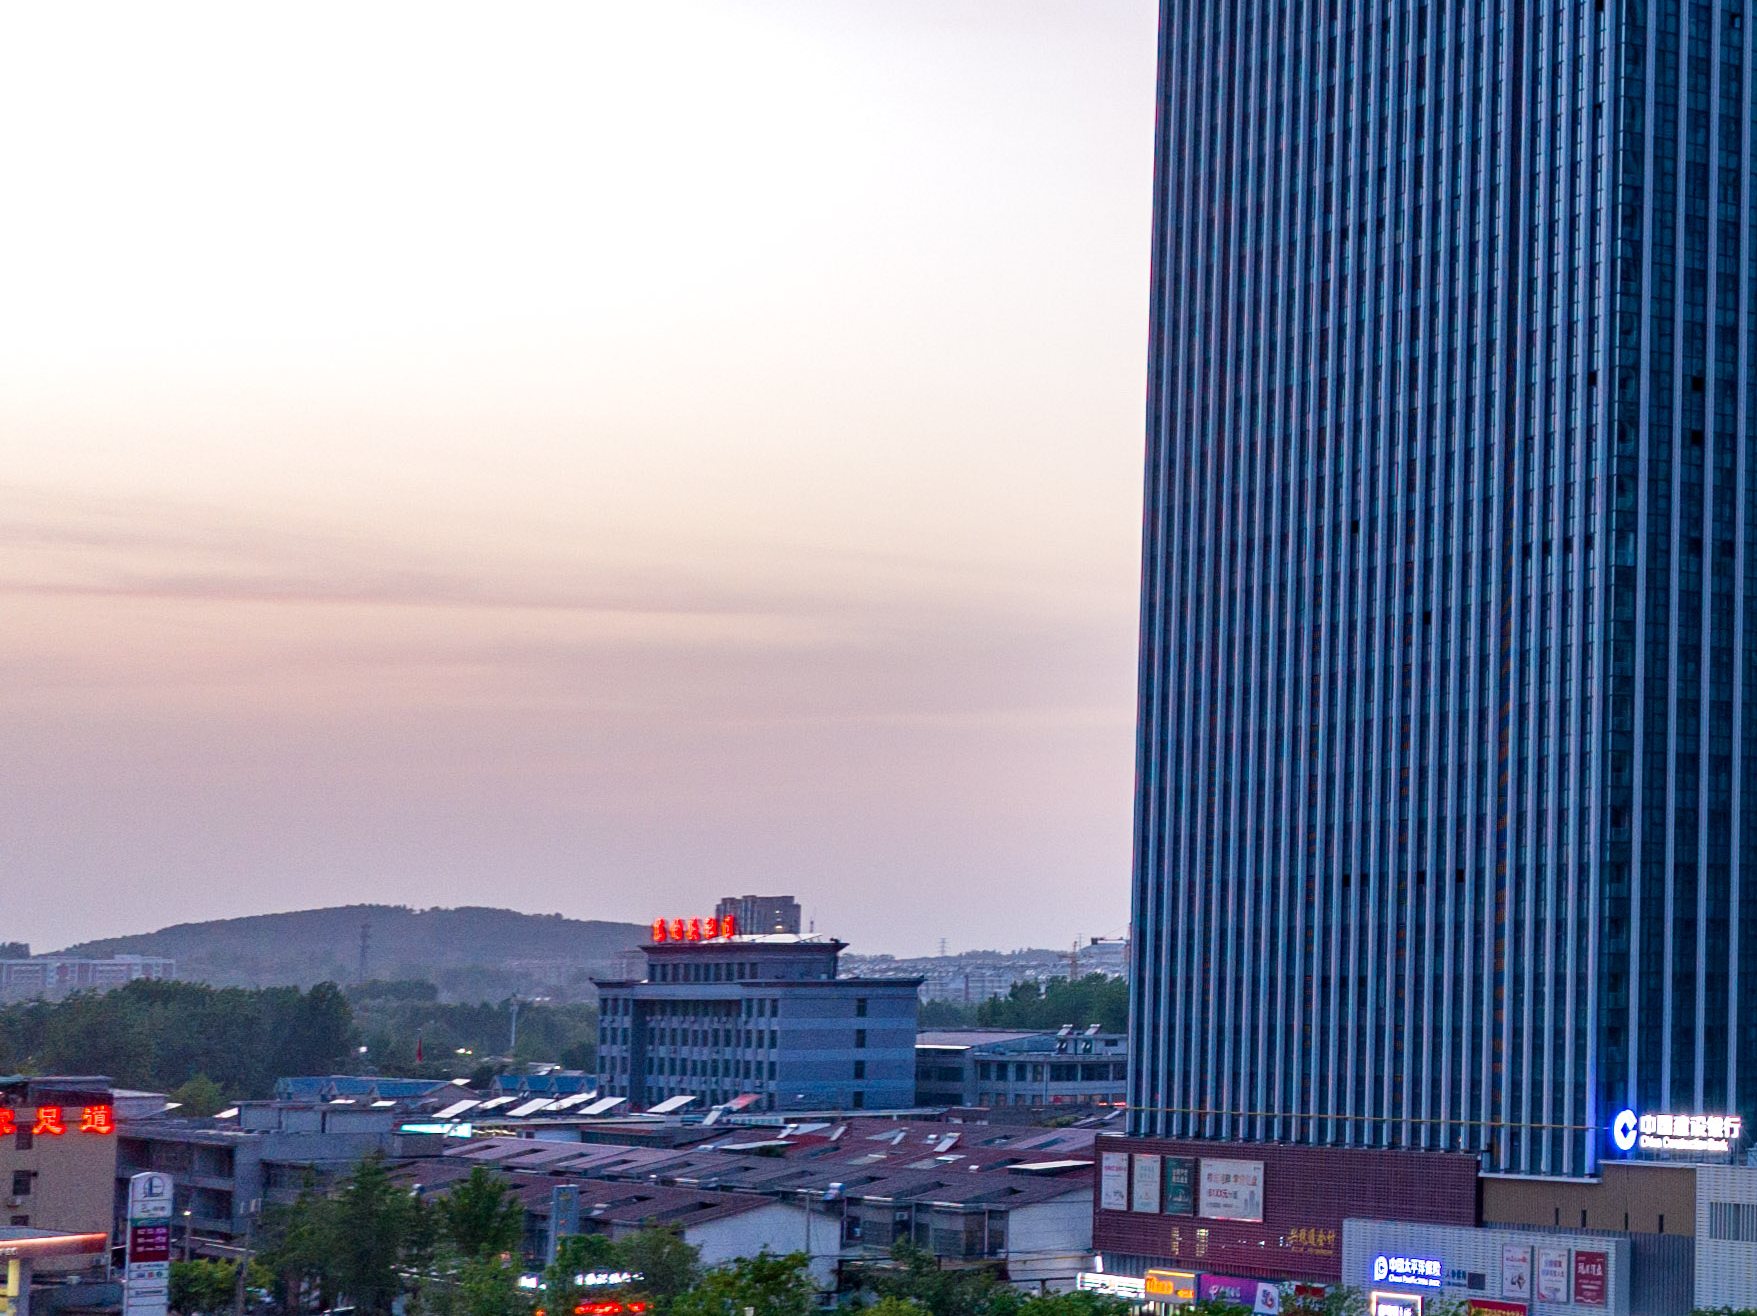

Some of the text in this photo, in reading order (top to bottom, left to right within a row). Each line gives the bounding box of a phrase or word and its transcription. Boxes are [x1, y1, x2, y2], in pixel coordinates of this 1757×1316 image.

[1639, 1114, 1742, 1138] 中国建设银行
